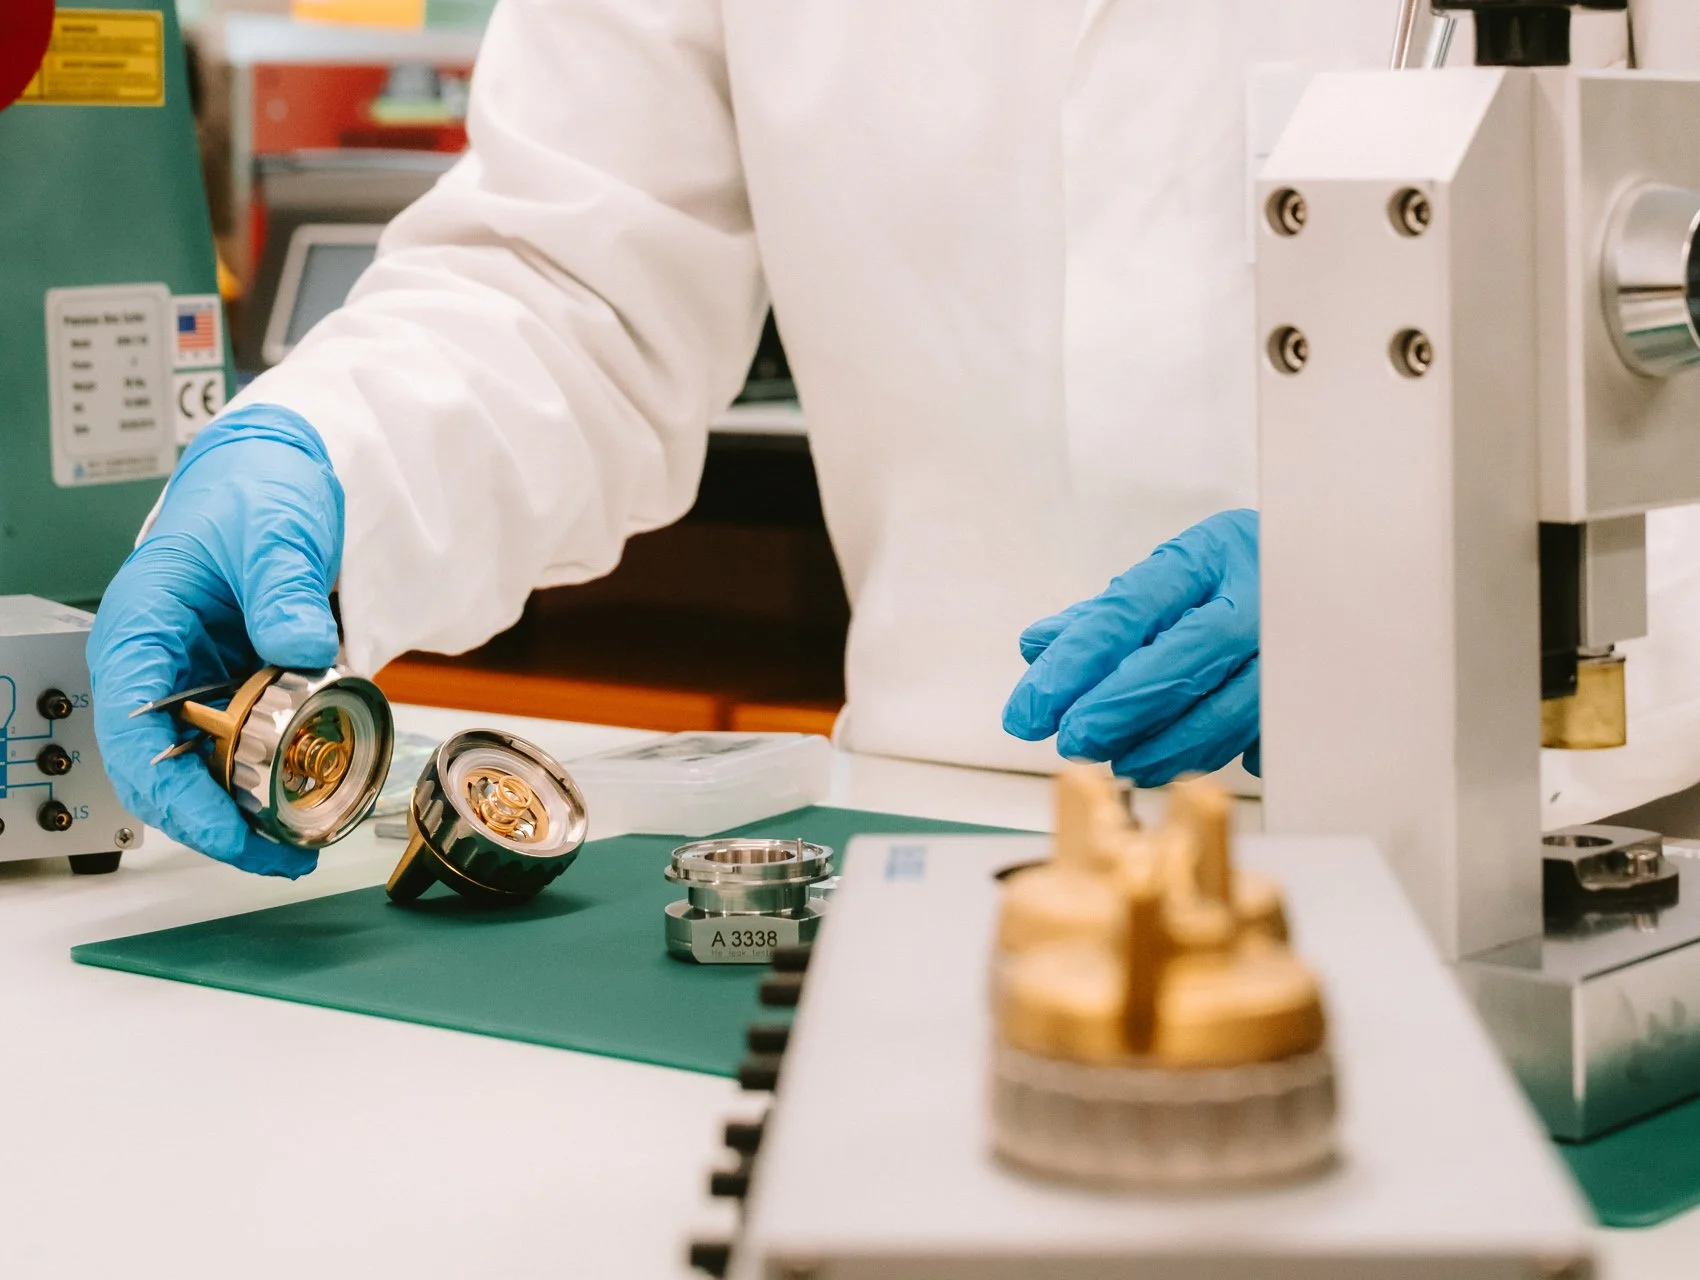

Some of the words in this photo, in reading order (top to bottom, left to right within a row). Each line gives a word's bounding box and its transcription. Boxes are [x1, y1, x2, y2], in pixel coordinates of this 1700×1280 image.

[72, 693, 89, 709] 2S
[72, 751, 81, 764] R
[72, 805, 89, 820] 1S
[711, 931, 726, 948] A
[731, 930, 778, 948] 3338
